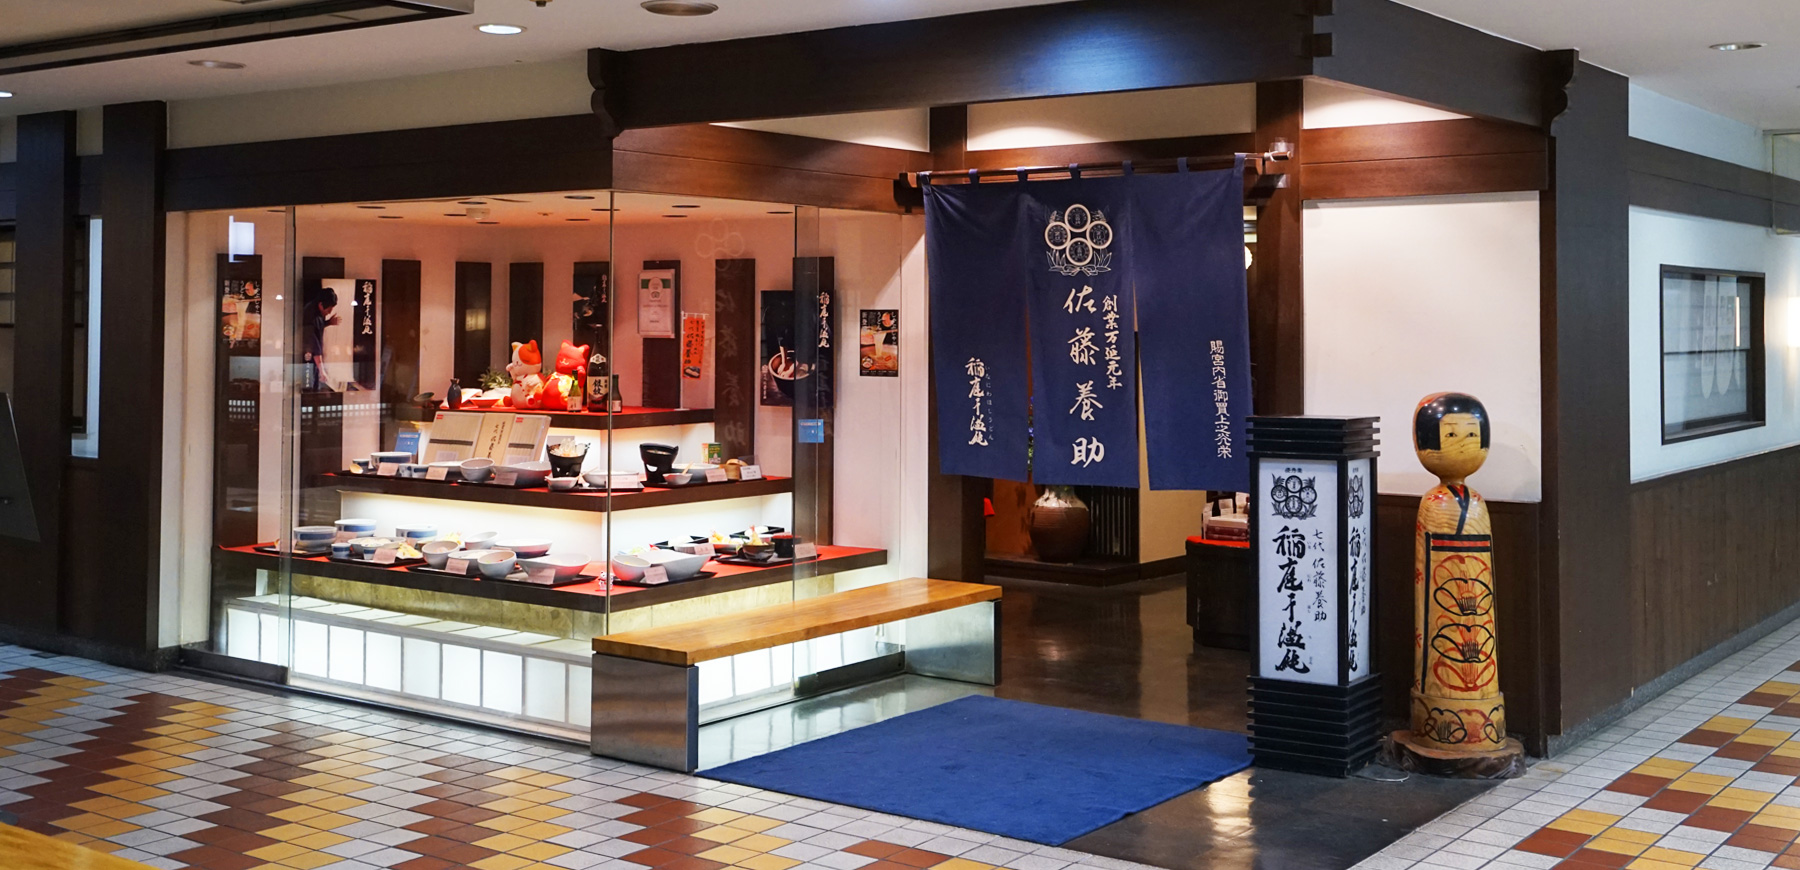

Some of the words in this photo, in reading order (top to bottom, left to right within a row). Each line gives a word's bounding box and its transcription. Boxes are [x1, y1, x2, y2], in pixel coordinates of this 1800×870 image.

[1063, 284, 1105, 468] 佐藤養助
[1101, 294, 1123, 390] 創業万延元年
[984, 365, 994, 441] いなにわほしうどん
[1209, 339, 1233, 459] 賜宮内省御買上之光栄
[1312, 557, 1328, 622] 佐藤養助
